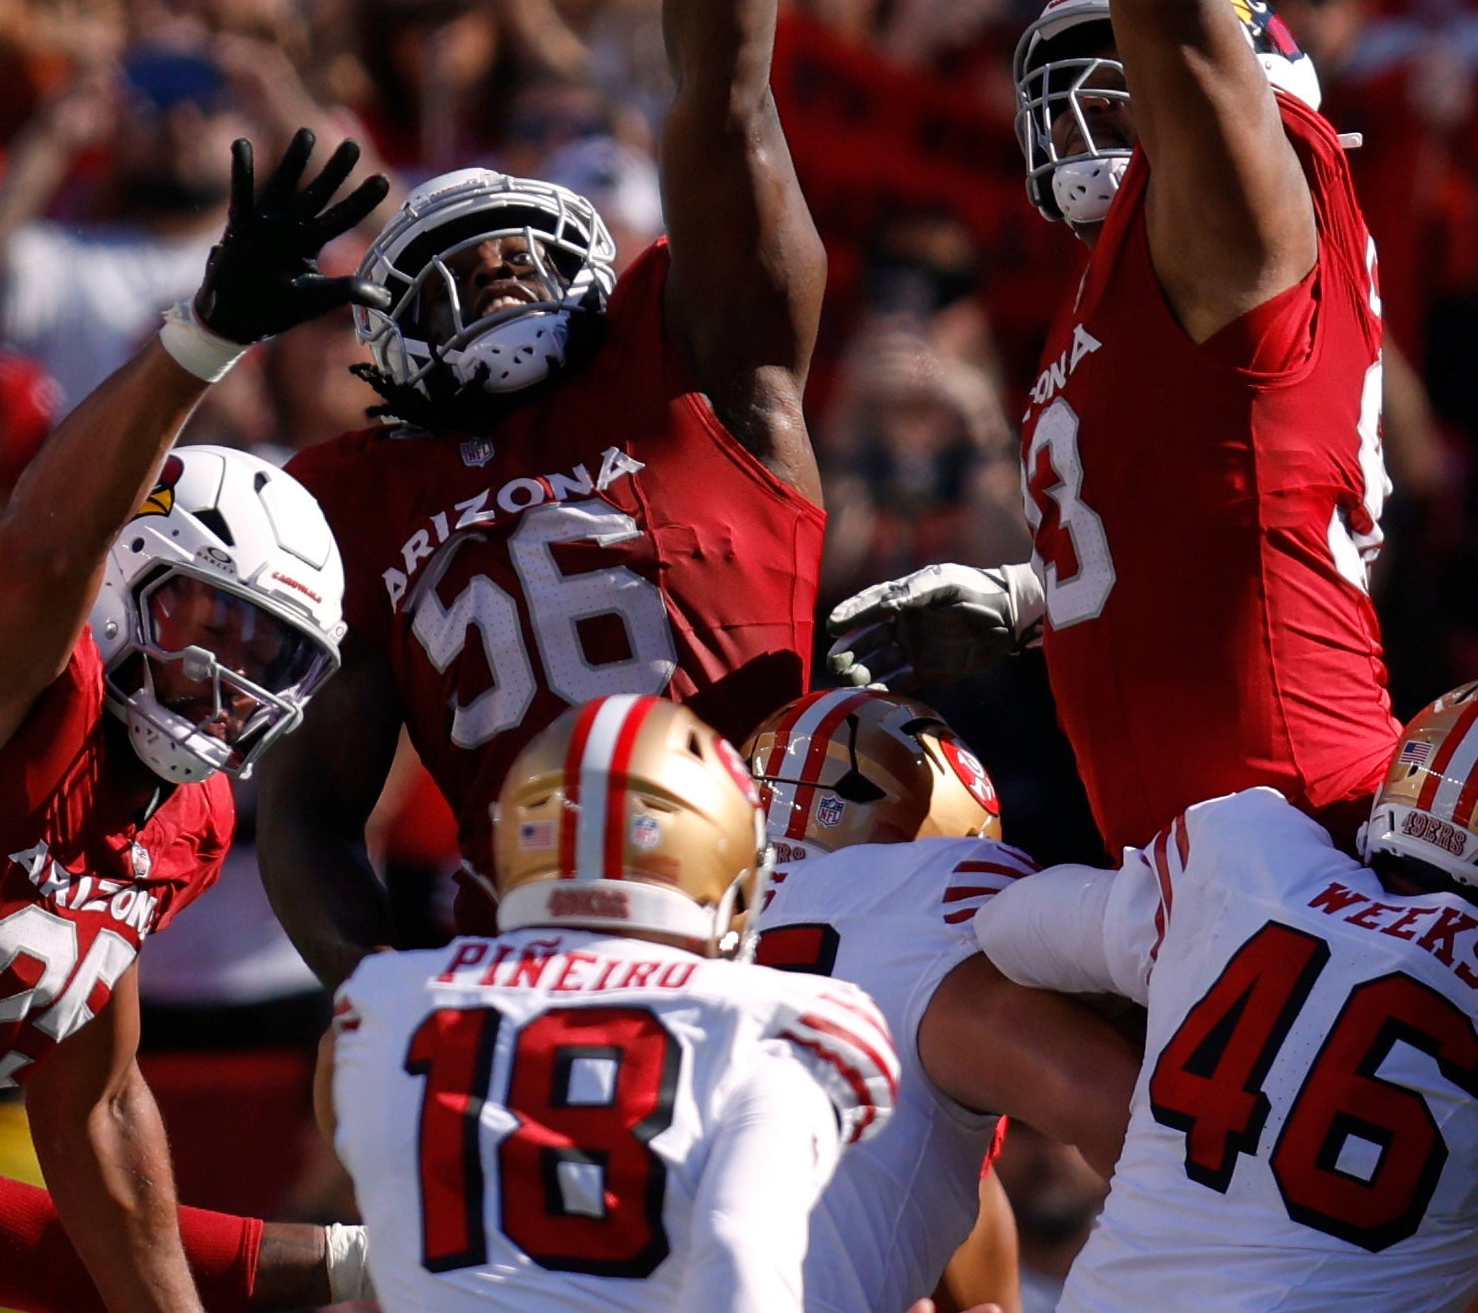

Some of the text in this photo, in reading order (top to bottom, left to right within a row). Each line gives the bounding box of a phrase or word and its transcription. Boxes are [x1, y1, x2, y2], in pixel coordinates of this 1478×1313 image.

[196, 550, 235, 575] OAKLEY
[381, 445, 646, 615] ARIZONA
[1020, 394, 1117, 632] 3
[401, 498, 679, 751] 56
[1400, 810, 1468, 857] 49ERS
[437, 934, 699, 993] PIÑEIRO
[404, 1004, 684, 1280] 18
